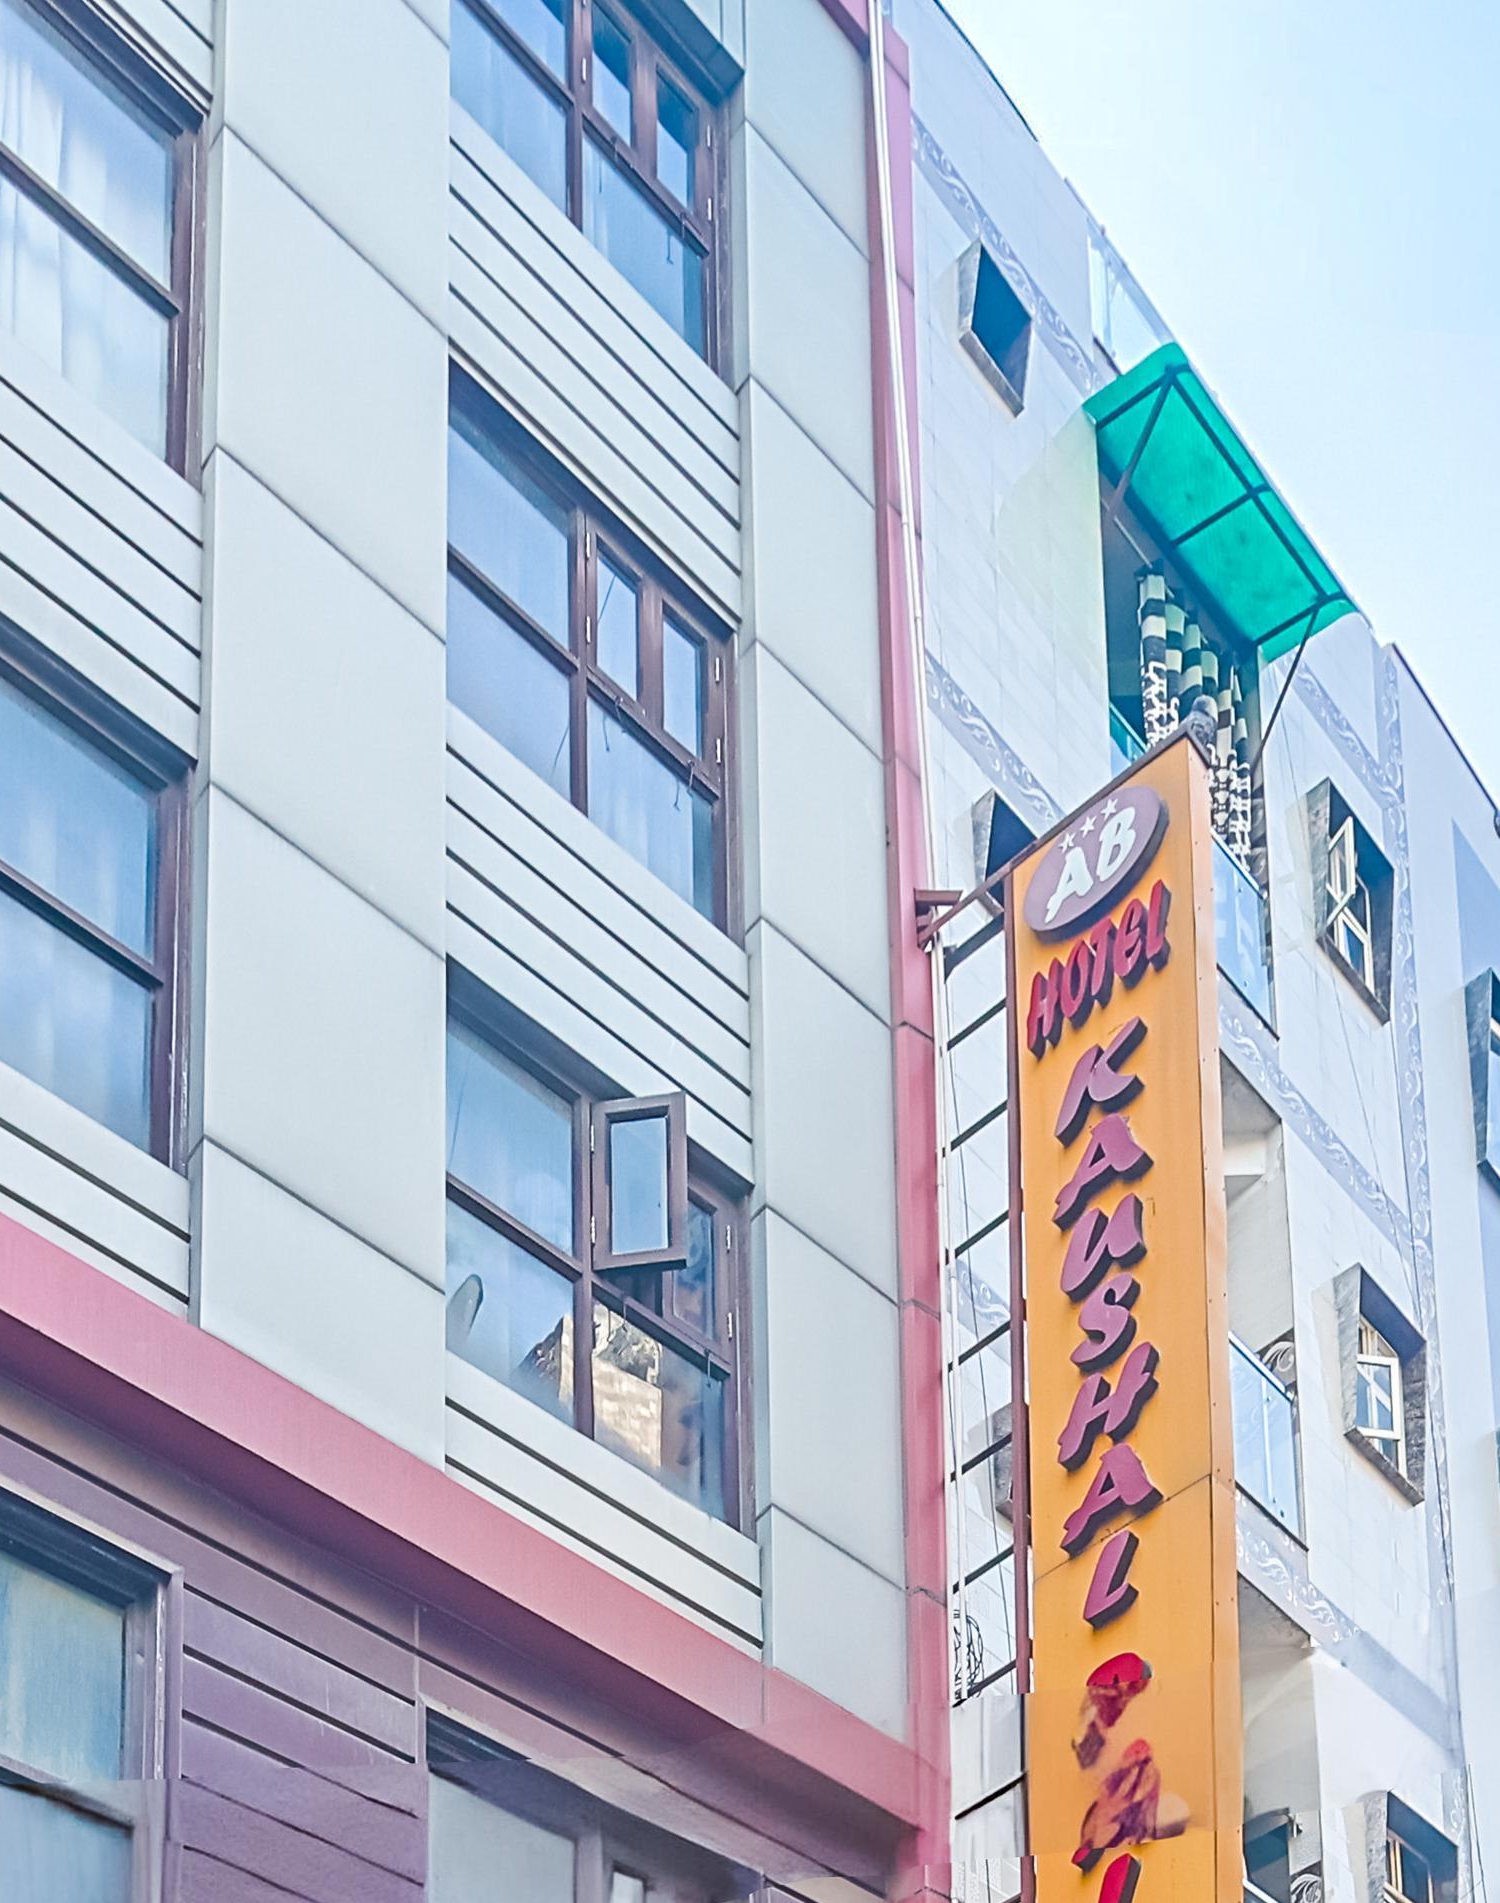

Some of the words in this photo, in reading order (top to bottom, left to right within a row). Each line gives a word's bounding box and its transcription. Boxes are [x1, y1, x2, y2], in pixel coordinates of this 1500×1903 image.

[1045, 804, 1138, 925] AB
[1026, 878, 1172, 1058] HOTEL
[1052, 1016, 1164, 1632] KAUSHAL
